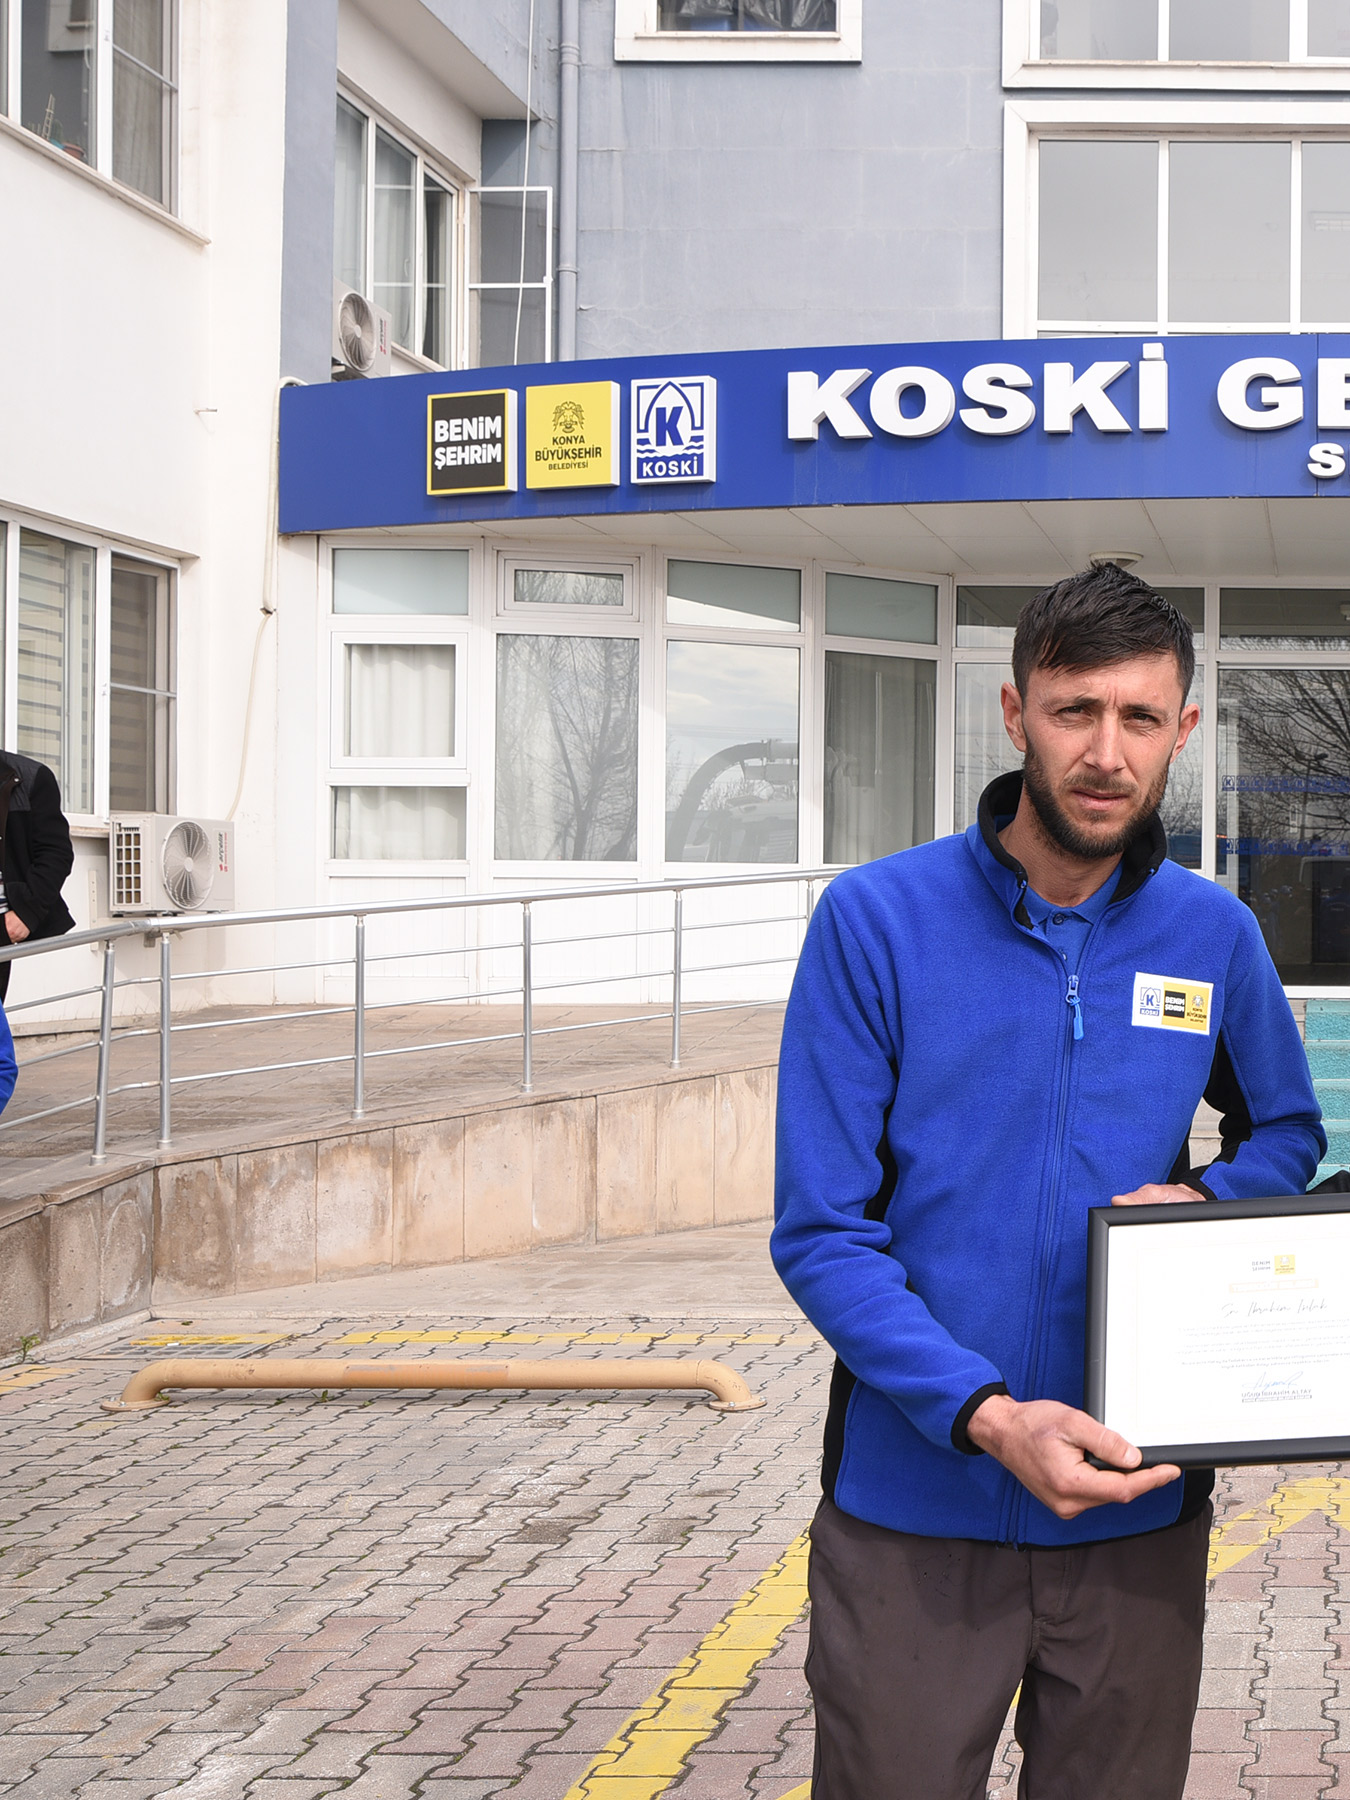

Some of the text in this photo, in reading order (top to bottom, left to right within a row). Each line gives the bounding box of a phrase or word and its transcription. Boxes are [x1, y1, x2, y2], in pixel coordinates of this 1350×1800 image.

[787, 343, 1168, 441] KOSKİ
[656, 406, 684, 447] K
[552, 435, 585, 446] KONYA
[535, 445, 602, 462] BÜYÜKŞEHİR
[548, 460, 589, 471] BELEDİYESİ
[642, 456, 698, 478] KOSKİ
